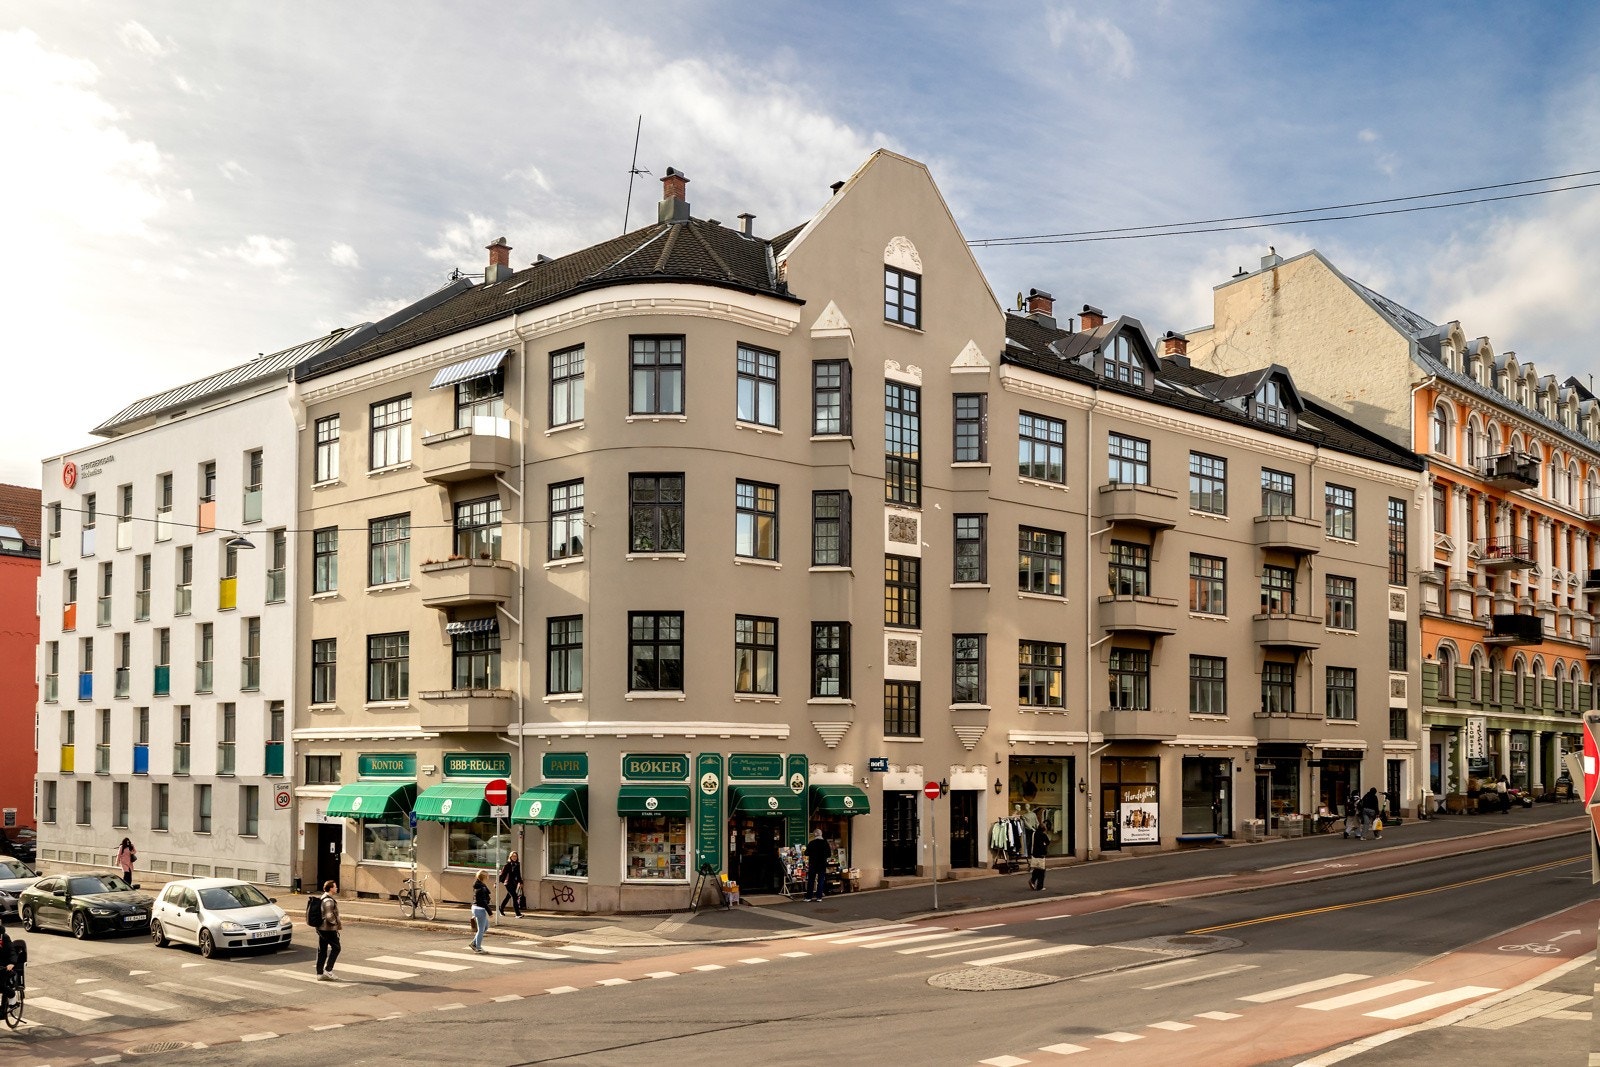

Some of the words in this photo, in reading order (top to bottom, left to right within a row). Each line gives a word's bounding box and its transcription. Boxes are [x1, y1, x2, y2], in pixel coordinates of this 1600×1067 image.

[371, 760, 404, 770] KONTOR
[450, 759, 505, 770] BBB-REOLER
[551, 760, 580, 771] PAPIR
[630, 760, 682, 774] BØKER
[1025, 771, 1058, 784] VITO
[279, 795, 288, 804] 30
